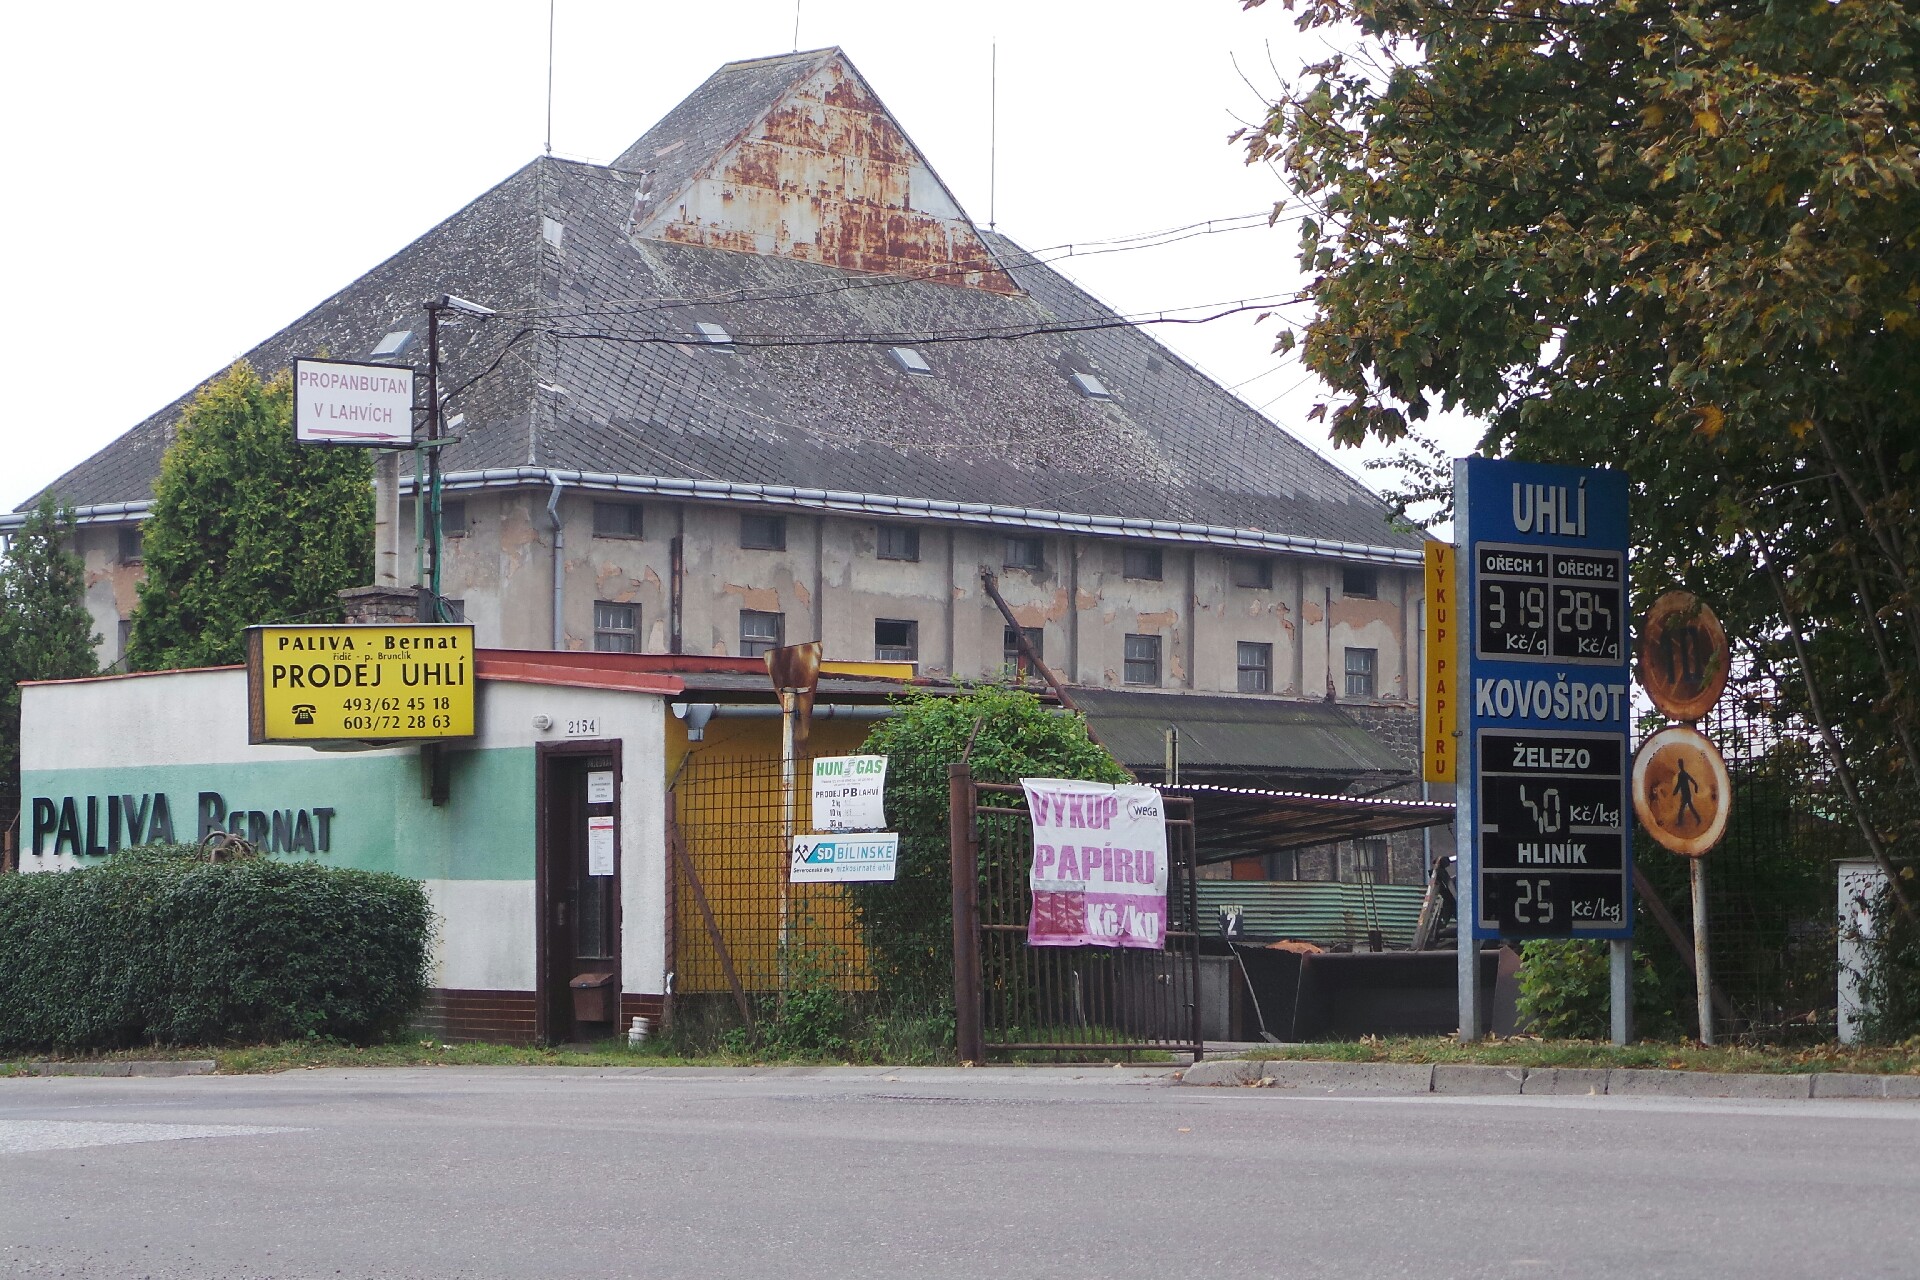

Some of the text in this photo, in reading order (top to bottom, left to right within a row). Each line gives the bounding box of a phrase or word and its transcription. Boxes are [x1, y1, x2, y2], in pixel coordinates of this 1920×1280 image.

[300, 371, 407, 394] PROPANBUTAN
[314, 403, 393, 423] V LAHVÍCH
[1512, 476, 1587, 536] UHLÍ
[1486, 554, 1543, 574] OŘECH 1
[1558, 559, 1614, 578] OŘECH 2
[1557, 589, 1611, 633] 284
[279, 636, 355, 651] PALIVA
[385, 635, 458, 650] Bernat
[333, 652, 352, 661] řidič
[1435, 549, 1446, 775] VÝKUP PAPÍRU
[272, 655, 465, 688] PRODEJ UHLÍ
[342, 697, 450, 713] 493/62 45 18
[1476, 672, 1625, 722] KOVOŠROT
[343, 715, 451, 731] 603/72 28 63
[568, 719, 596, 734] 2154
[1513, 743, 1591, 769] ŽELEZO
[843, 788, 858, 798] PB
[1032, 788, 1118, 830] VÝKUP
[1570, 803, 1619, 829] Kč/kg
[32, 792, 175, 855] PALIVA
[817, 847, 833, 860] SD
[1034, 842, 1155, 885] PAPÍRU
[1518, 840, 1587, 864] HLINÍK
[1220, 905, 1243, 915] MOST
[1515, 879, 1620, 924] 25 Kč/kg
[1087, 903, 1158, 943] Kč/kg
[1226, 914, 1237, 936] 2
